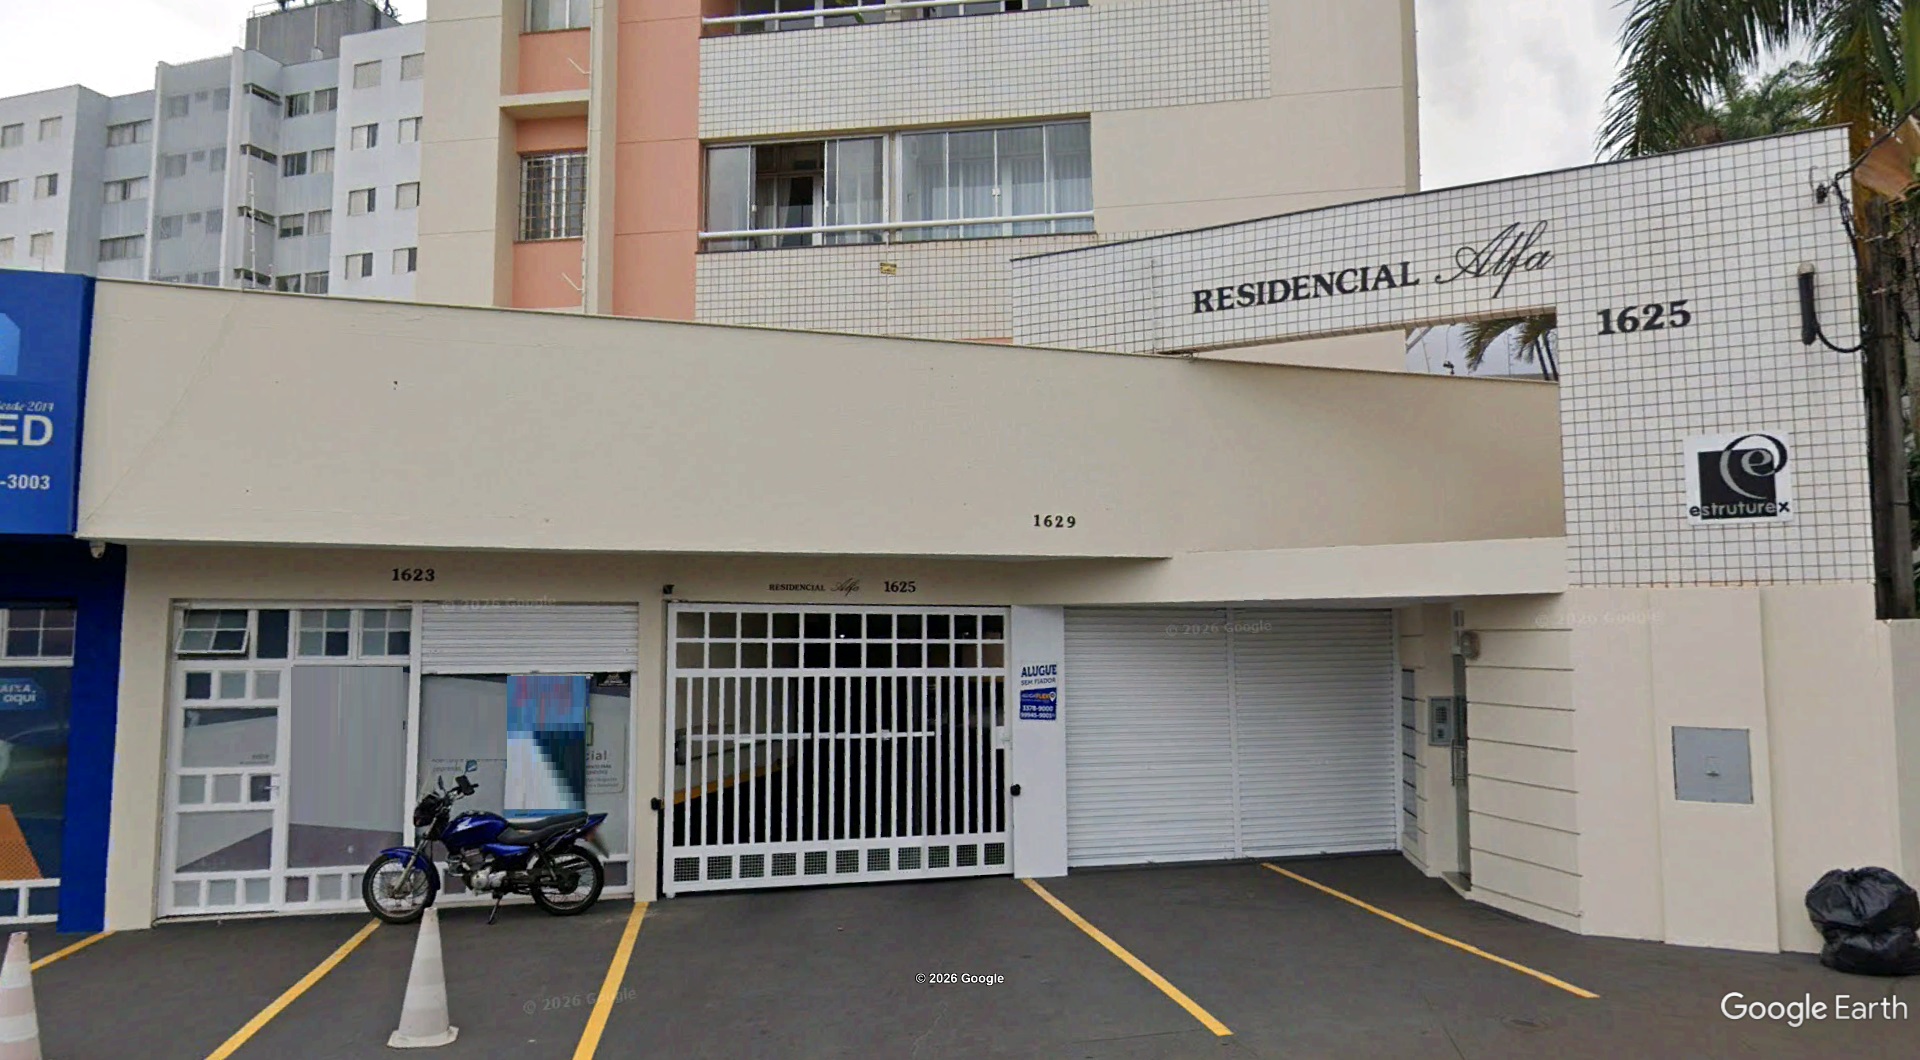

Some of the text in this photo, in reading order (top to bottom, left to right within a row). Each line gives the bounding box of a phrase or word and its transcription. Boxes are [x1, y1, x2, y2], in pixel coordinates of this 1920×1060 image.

[1192, 220, 1554, 314] RESIDENCIAL Alfa
[1597, 299, 1691, 335] 1625
[1689, 501, 1790, 517] estruturex
[1033, 514, 1076, 529] 1629
[392, 568, 435, 582] 1623
[768, 583, 826, 592] RESIDENCIAL
[884, 580, 917, 593] 1625
[1021, 664, 1057, 678] ALUGUE
